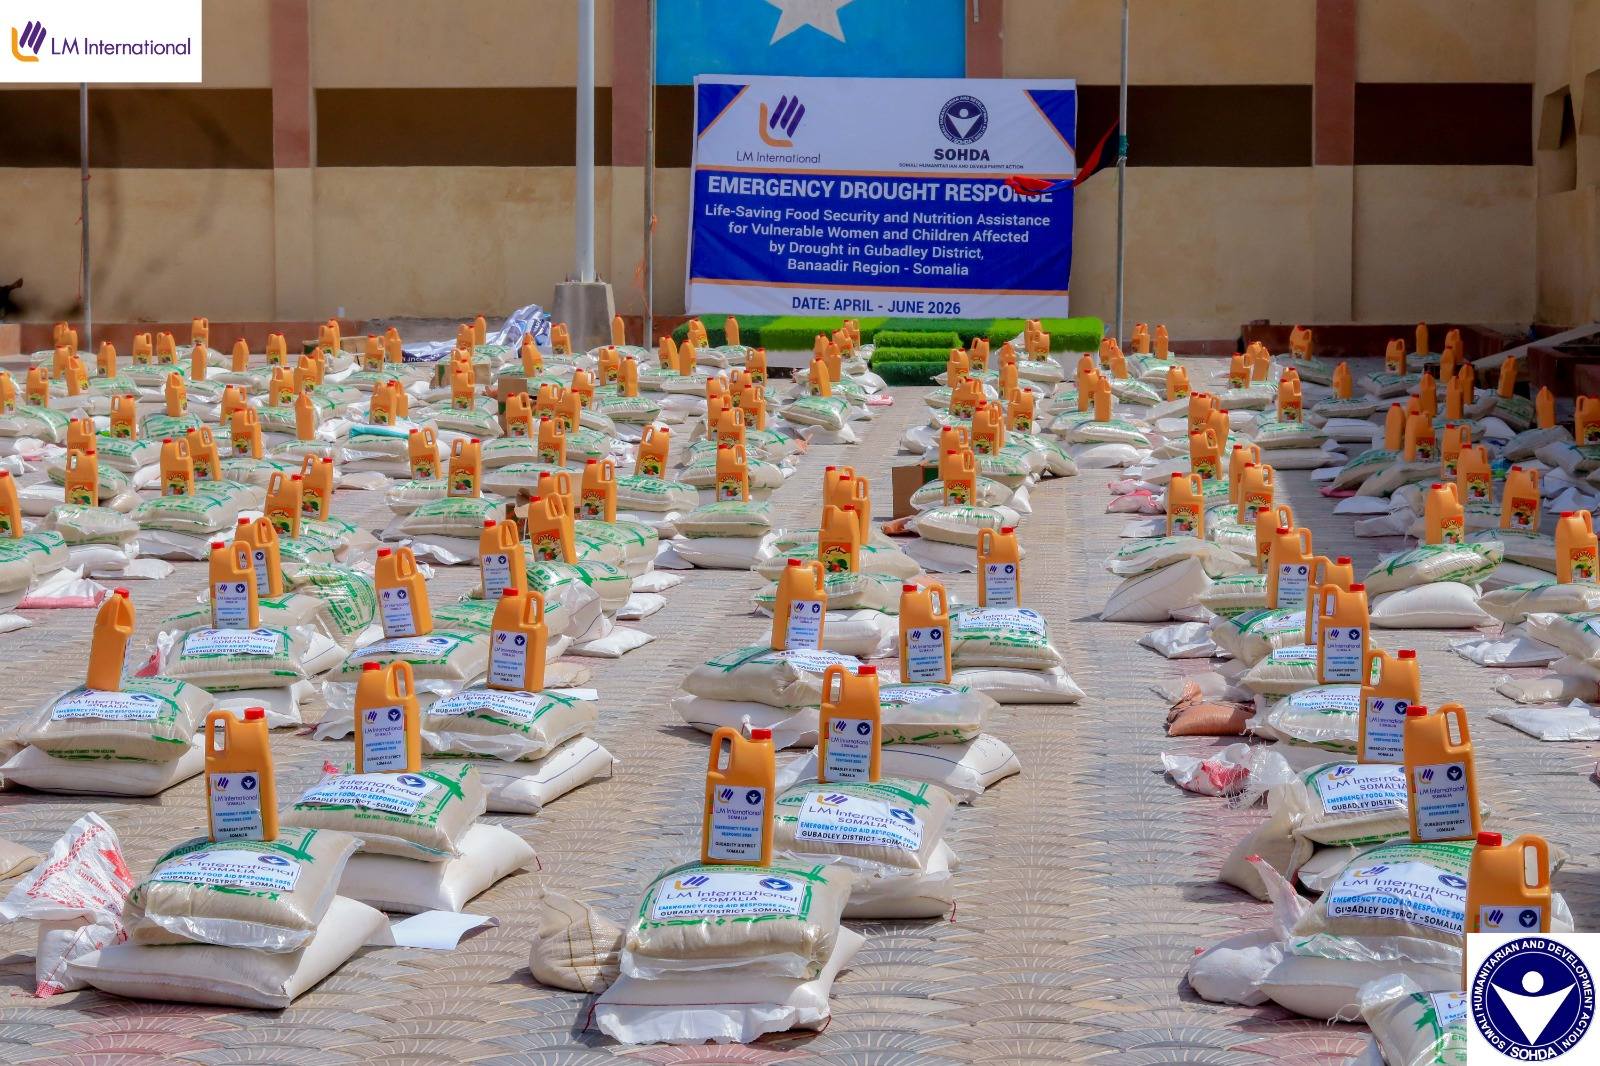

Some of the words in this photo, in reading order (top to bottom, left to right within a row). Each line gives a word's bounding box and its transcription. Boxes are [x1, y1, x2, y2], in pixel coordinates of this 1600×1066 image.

[736, 151, 753, 162] LM
[756, 152, 821, 164] International
[934, 148, 990, 161] SOHDA
[707, 175, 835, 198] EMERGENCY
[839, 181, 940, 201] DROUGHT
[705, 204, 781, 221] Life-Saving
[786, 208, 819, 220] Food
[824, 209, 879, 225] Security
[883, 211, 909, 223] and
[913, 212, 973, 225] Nutrition
[977, 213, 1050, 226] Assistance
[728, 222, 748, 234] for
[751, 223, 823, 236] Vulnerable
[828, 226, 879, 239] Women
[883, 228, 908, 240] and
[912, 229, 969, 242] Children
[972, 230, 1029, 243] Affected
[769, 240, 785, 254] by
[789, 242, 843, 256] Drought
[848, 244, 860, 256] in
[864, 244, 928, 260] Gubadley
[932, 246, 984, 261] District,
[787, 258, 848, 272] Banaadir
[852, 261, 900, 276] Region
[913, 262, 969, 276] Somalia
[792, 297, 830, 310] DATE:
[834, 298, 873, 312] APRIL
[888, 300, 924, 313] JUNE
[928, 302, 961, 314] 2026
[338, 785, 387, 794] SOMALIA
[339, 779, 423, 797] International
[1328, 780, 1350, 790] LM
[1430, 785, 1464, 793] International
[368, 794, 399, 802] RESPONSE
[1327, 795, 1363, 803] EMERGENCY
[809, 806, 832, 814] LM
[836, 809, 919, 837] International
[838, 817, 888, 829] SOMALIA
[800, 822, 838, 831] EMERGENCY
[871, 828, 902, 840] RESPONSE
[801, 831, 840, 840] GUBADLEY
[842, 833, 875, 842] DISTRICT
[198, 861, 294, 876] International
[238, 874, 273, 882] RESPONSE
[1343, 879, 1368, 887] LM
[698, 890, 797, 902] International
[1376, 887, 1433, 901] SOMALIA
[1378, 896, 1398, 904] FOOD
[1413, 900, 1450, 916] RESPONSE
[1380, 907, 1418, 920] DISTRICT
